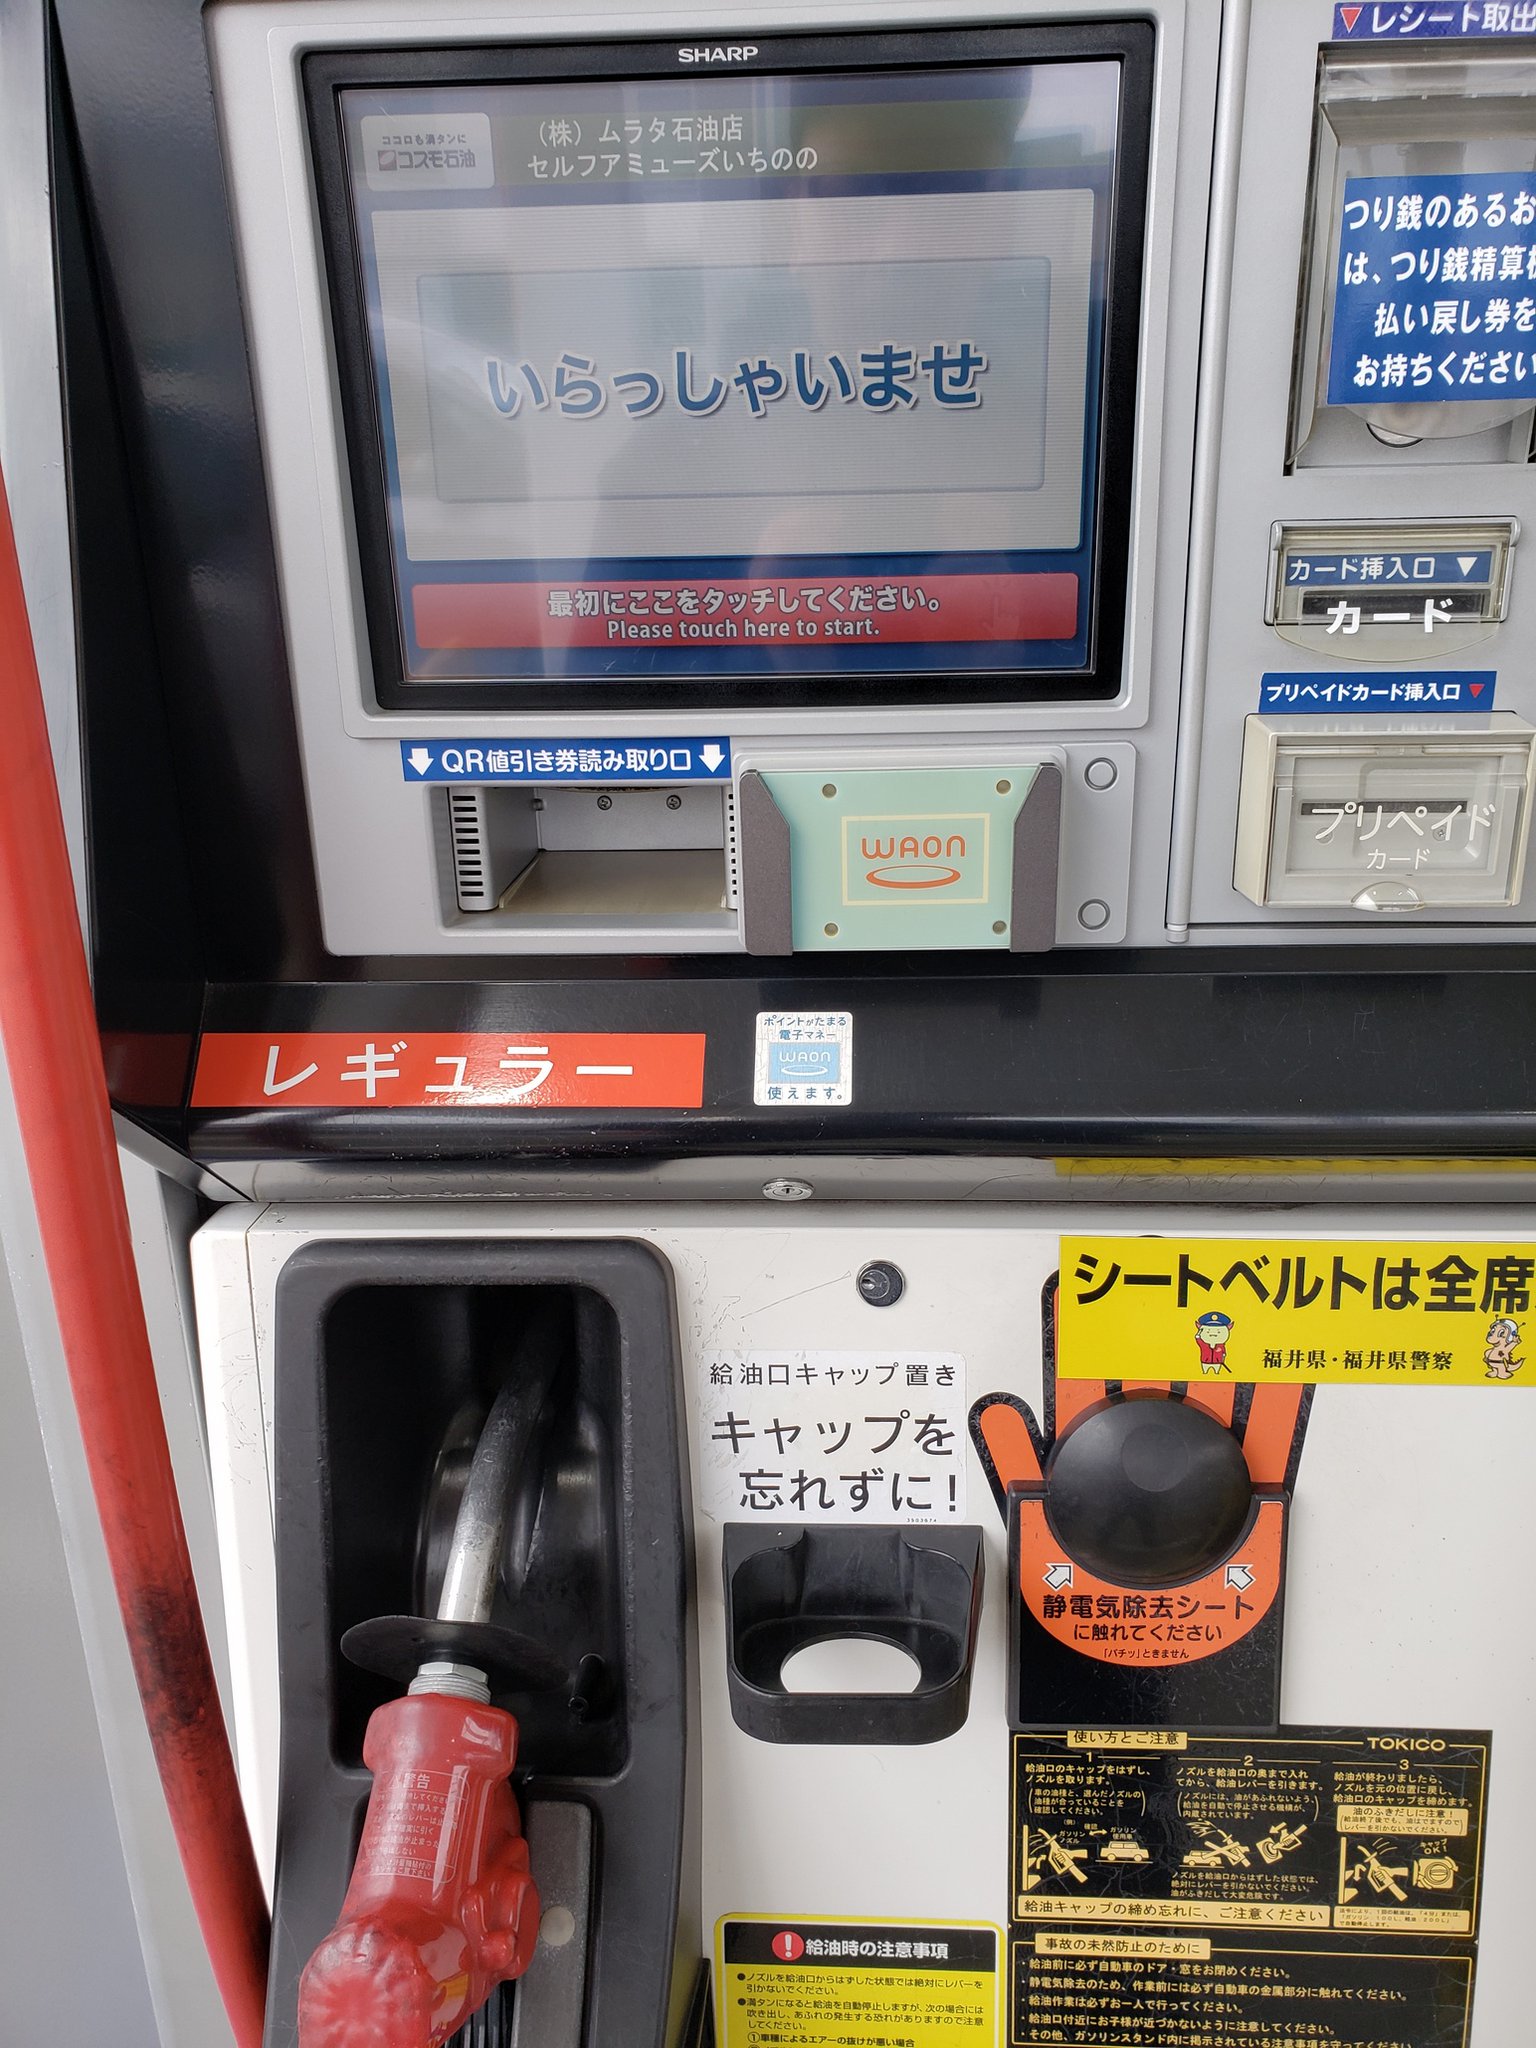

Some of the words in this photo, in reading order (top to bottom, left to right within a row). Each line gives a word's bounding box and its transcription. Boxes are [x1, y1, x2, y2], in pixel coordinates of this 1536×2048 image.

[678, 46, 758, 63] SHARP
[382, 133, 467, 145] ココロも満タンに
[540, 116, 743, 146] （株）ムラタ石油店
[398, 149, 476, 170] コスモ石油
[527, 146, 818, 179] セルフアミューズいちのの
[1344, 192, 1536, 232] つり銭のあるお
[485, 340, 989, 419] いらっしゃいませ
[1289, 556, 1436, 582] カード挿入口
[547, 586, 941, 617] 最初にここをタッチしてください。
[1325, 598, 1454, 634] カード
[607, 619, 674, 640] Please
[678, 618, 738, 638] touch
[744, 617, 790, 637] here
[797, 618, 818, 637] to
[823, 617, 880, 637] start.
[1266, 681, 1461, 702] プリペイドカード挿入口
[440, 746, 692, 775] QR値引き券読み取り口
[1312, 802, 1497, 842] プリペイド
[861, 834, 967, 860] WAON
[1366, 848, 1430, 871] カード
[764, 1014, 847, 1026] ポイントがたまる
[779, 1030, 836, 1040] 電子マネー
[779, 1051, 831, 1062] WAON
[261, 1039, 635, 1099] レギュラー
[767, 1087, 842, 1100] 使えます。
[1261, 1348, 1453, 1371] 福井県・福井県警察
[709, 1361, 957, 1387] 給油口キャップ置き
[711, 1408, 957, 1455] キャップを
[738, 1467, 957, 1513] 忘れずに！
[1043, 1594, 1254, 1620] 静電気除去シート
[1073, 1623, 1222, 1642] に触れてください
[1073, 1731, 1179, 1746] 使い方とご注意
[1367, 1737, 1446, 1752] TOKICO
[1086, 1752, 1093, 1762] 1
[1244, 1755, 1254, 1766] 2
[1399, 1759, 1409, 1770] 3
[1025, 1763, 1151, 1776] 給油口のキャップをはずし、
[1025, 1774, 1111, 1786] ノズルを取ります。
[1024, 1900, 1323, 1921] 給油キャップの締め忘れに、ご注意ください
[805, 1939, 949, 1960] 給油時の注意事項
[1045, 1937, 1200, 1954] 事故の未然防止のために
